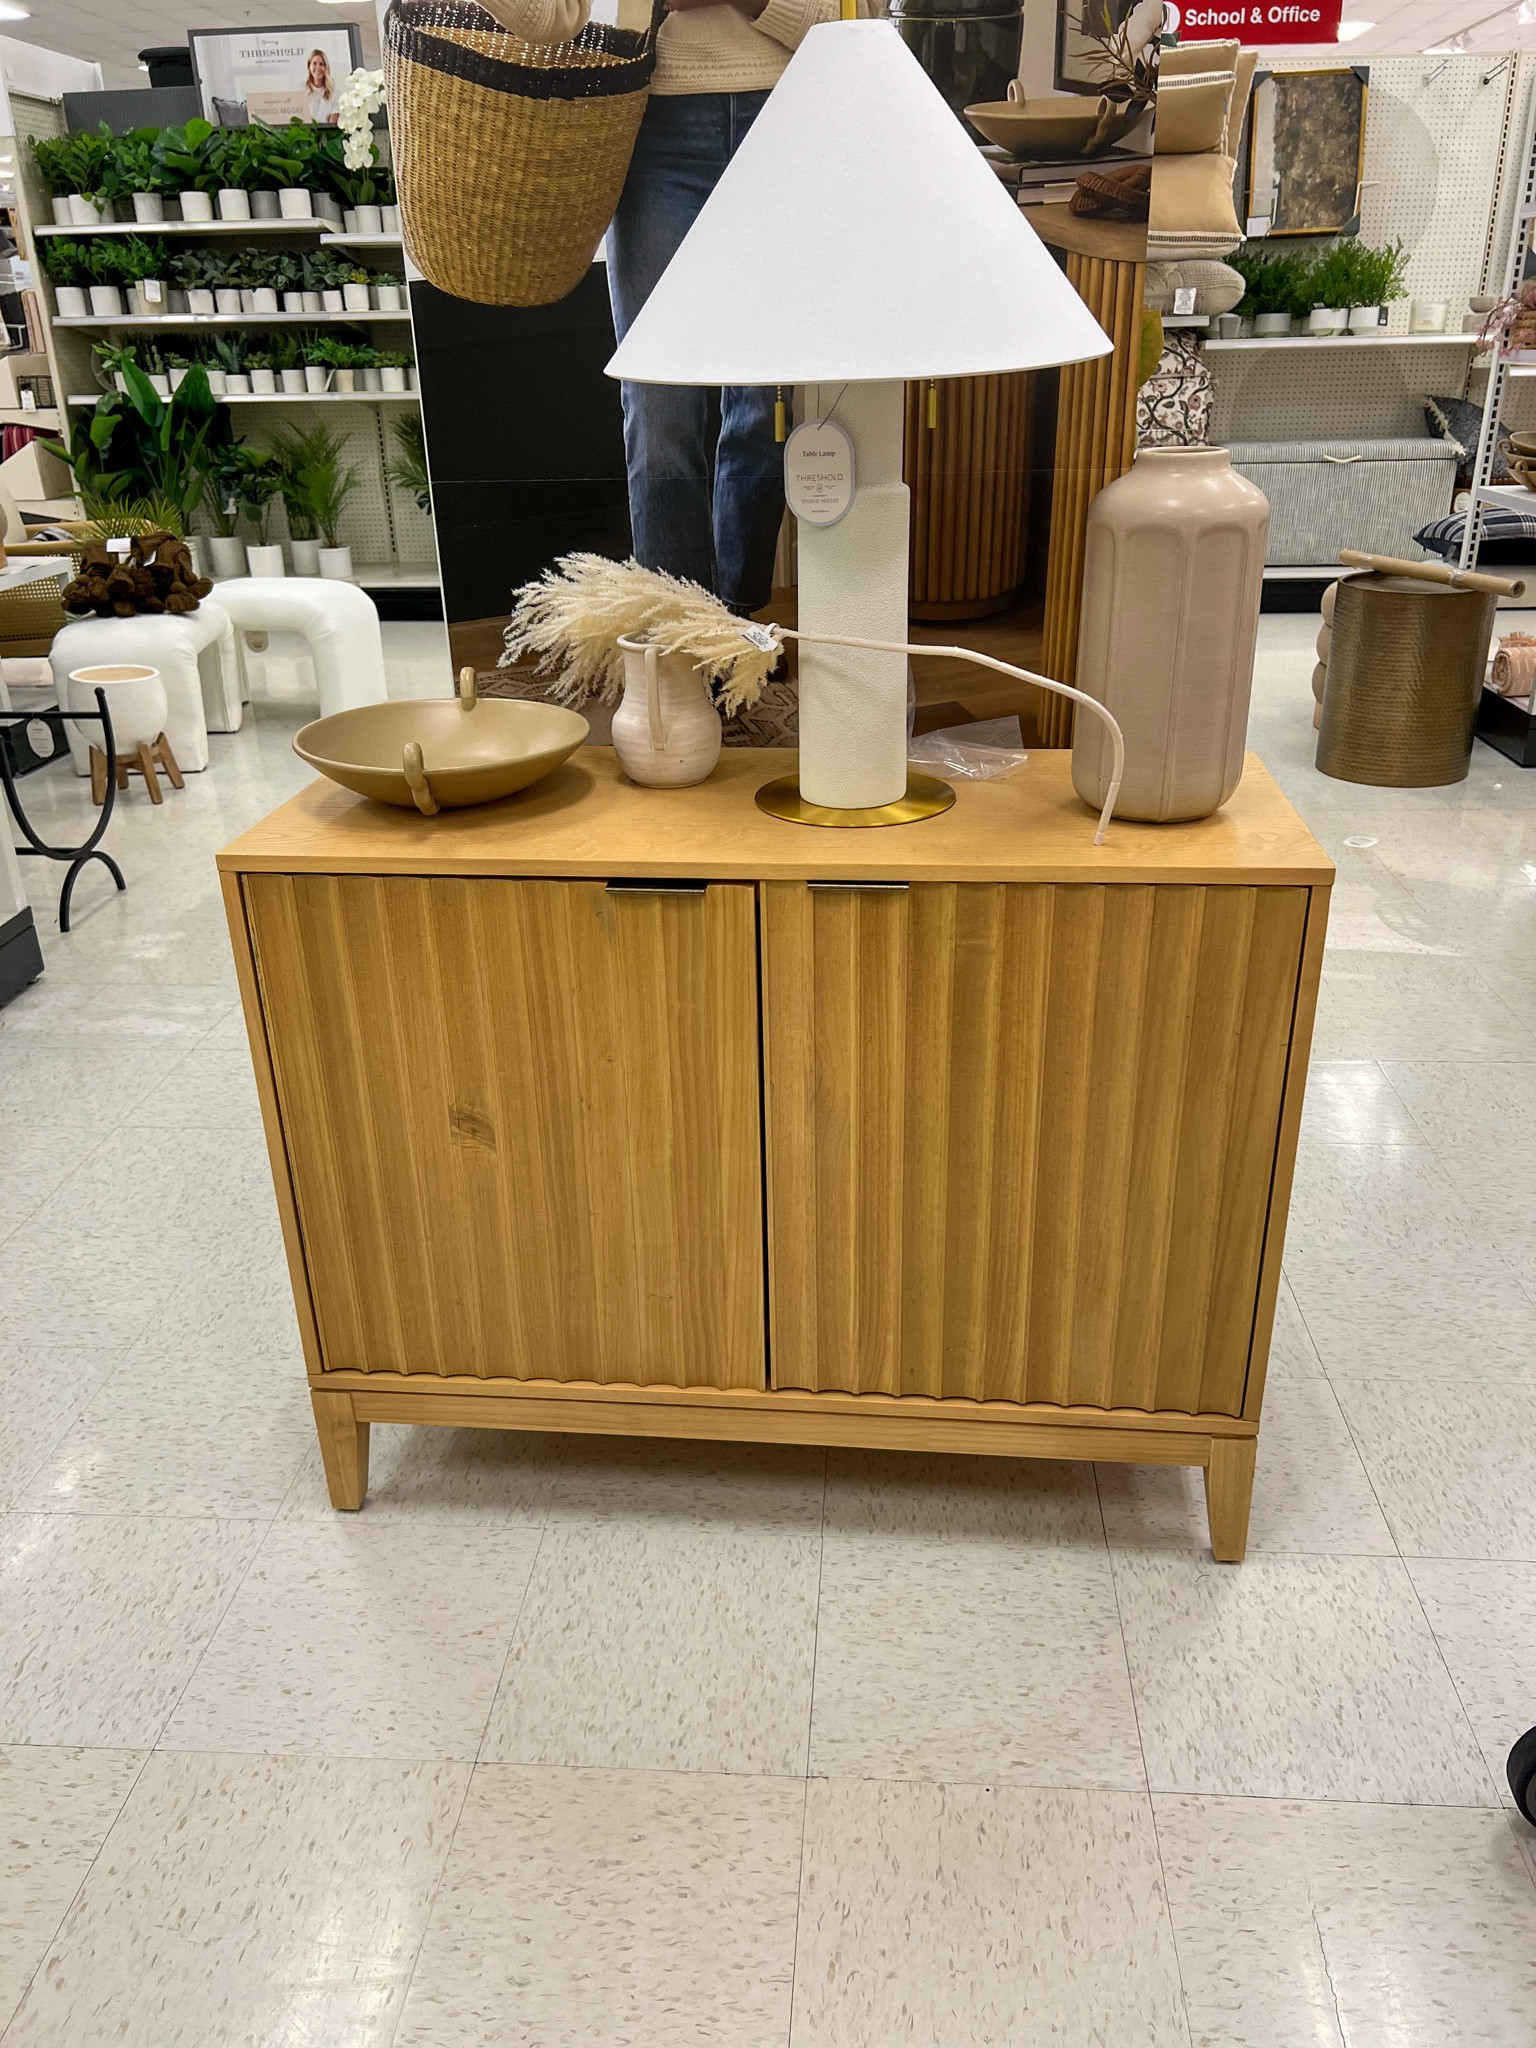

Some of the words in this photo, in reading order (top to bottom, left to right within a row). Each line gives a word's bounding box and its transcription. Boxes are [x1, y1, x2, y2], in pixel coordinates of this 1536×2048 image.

[1184, 8, 1246, 27] School
[1250, 7, 1263, 24] &
[1267, 6, 1321, 23] Office
[239, 47, 304, 58] THRESHOLD
[802, 450, 818, 458] Table
[819, 450, 836, 458] Lamp
[796, 473, 844, 482] THRESHOLD
